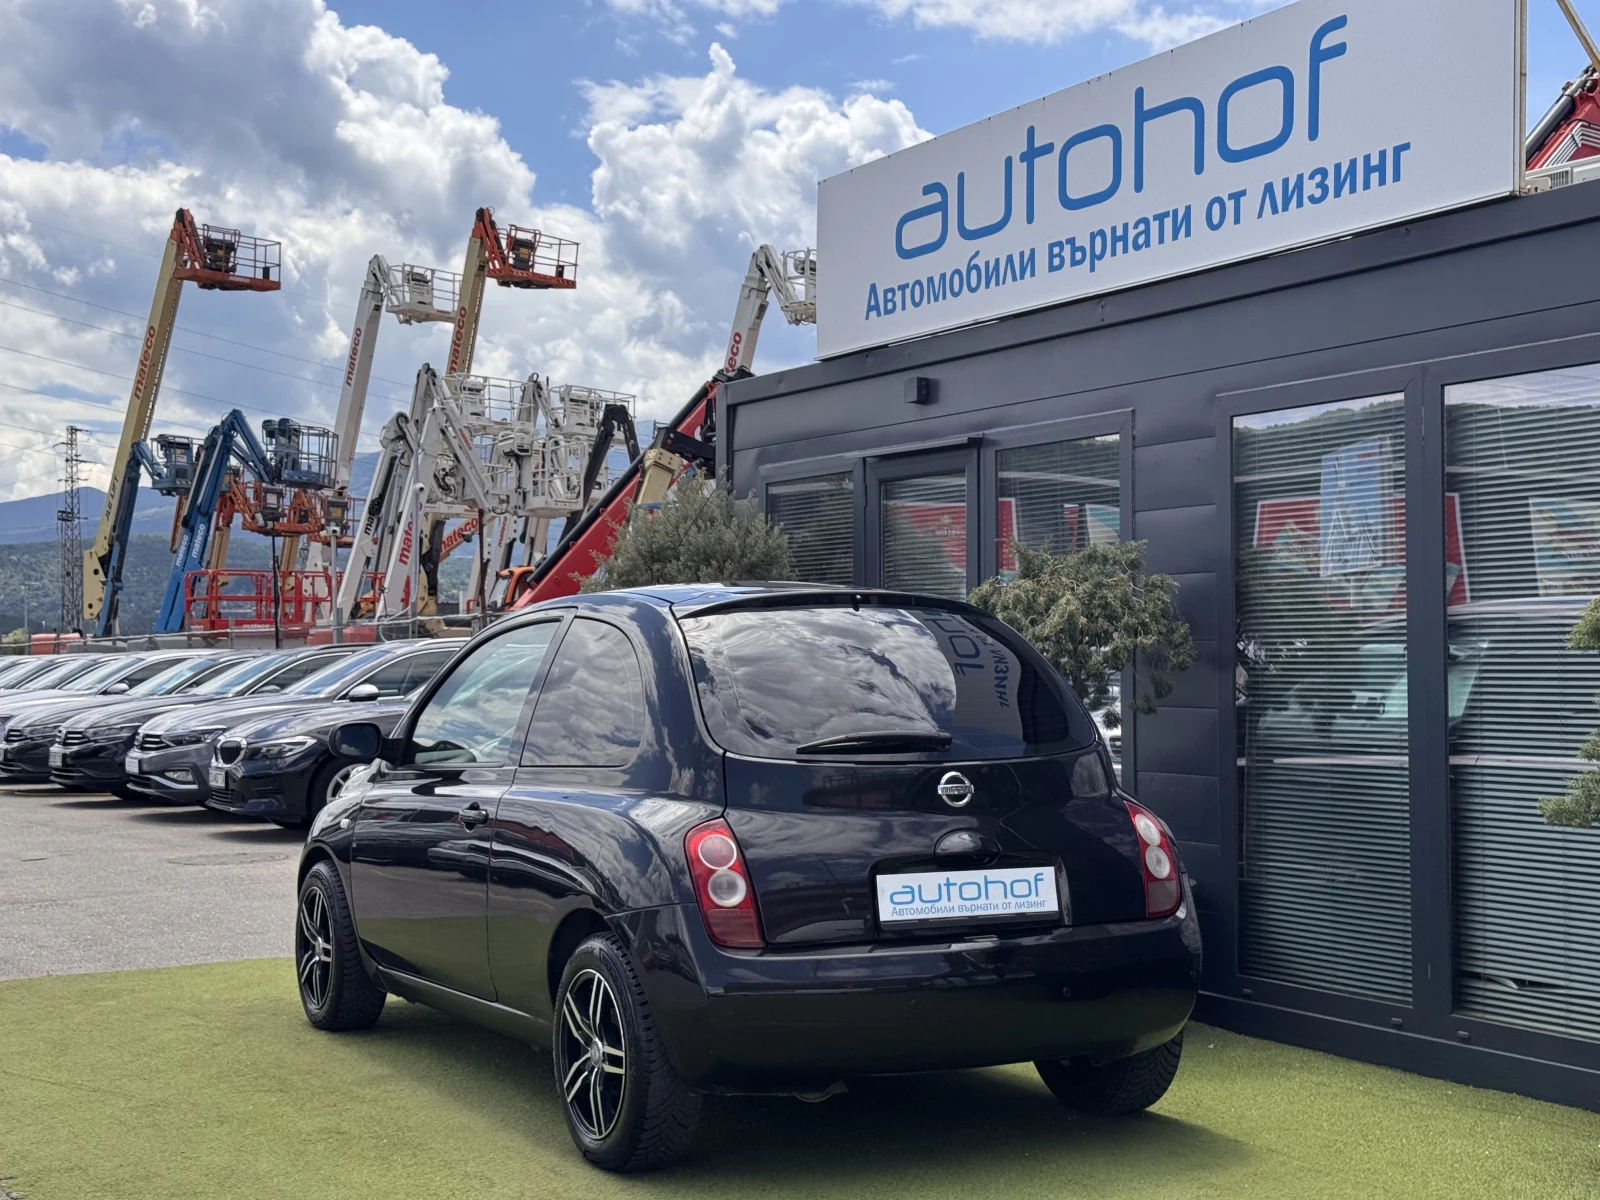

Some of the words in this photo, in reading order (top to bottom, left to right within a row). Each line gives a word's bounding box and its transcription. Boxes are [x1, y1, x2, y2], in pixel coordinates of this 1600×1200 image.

[895, 14, 1348, 260] autohof
[864, 250, 1037, 320] Автомобили
[1047, 206, 1192, 276] върнати
[1206, 189, 1247, 231] от
[1256, 141, 1411, 220] лизинг
[134, 325, 156, 400] mateco
[346, 327, 362, 387] mateco
[191, 523, 205, 559] mateco
[498, 516, 508, 548] mateco
[175, 534, 188, 567] mateco
[890, 872, 1044, 905] autohof
[891, 904, 955, 917] Автомобили
[958, 901, 999, 914] върнати
[1001, 902, 1013, 911] от
[1014, 900, 1047, 911] лизинг
